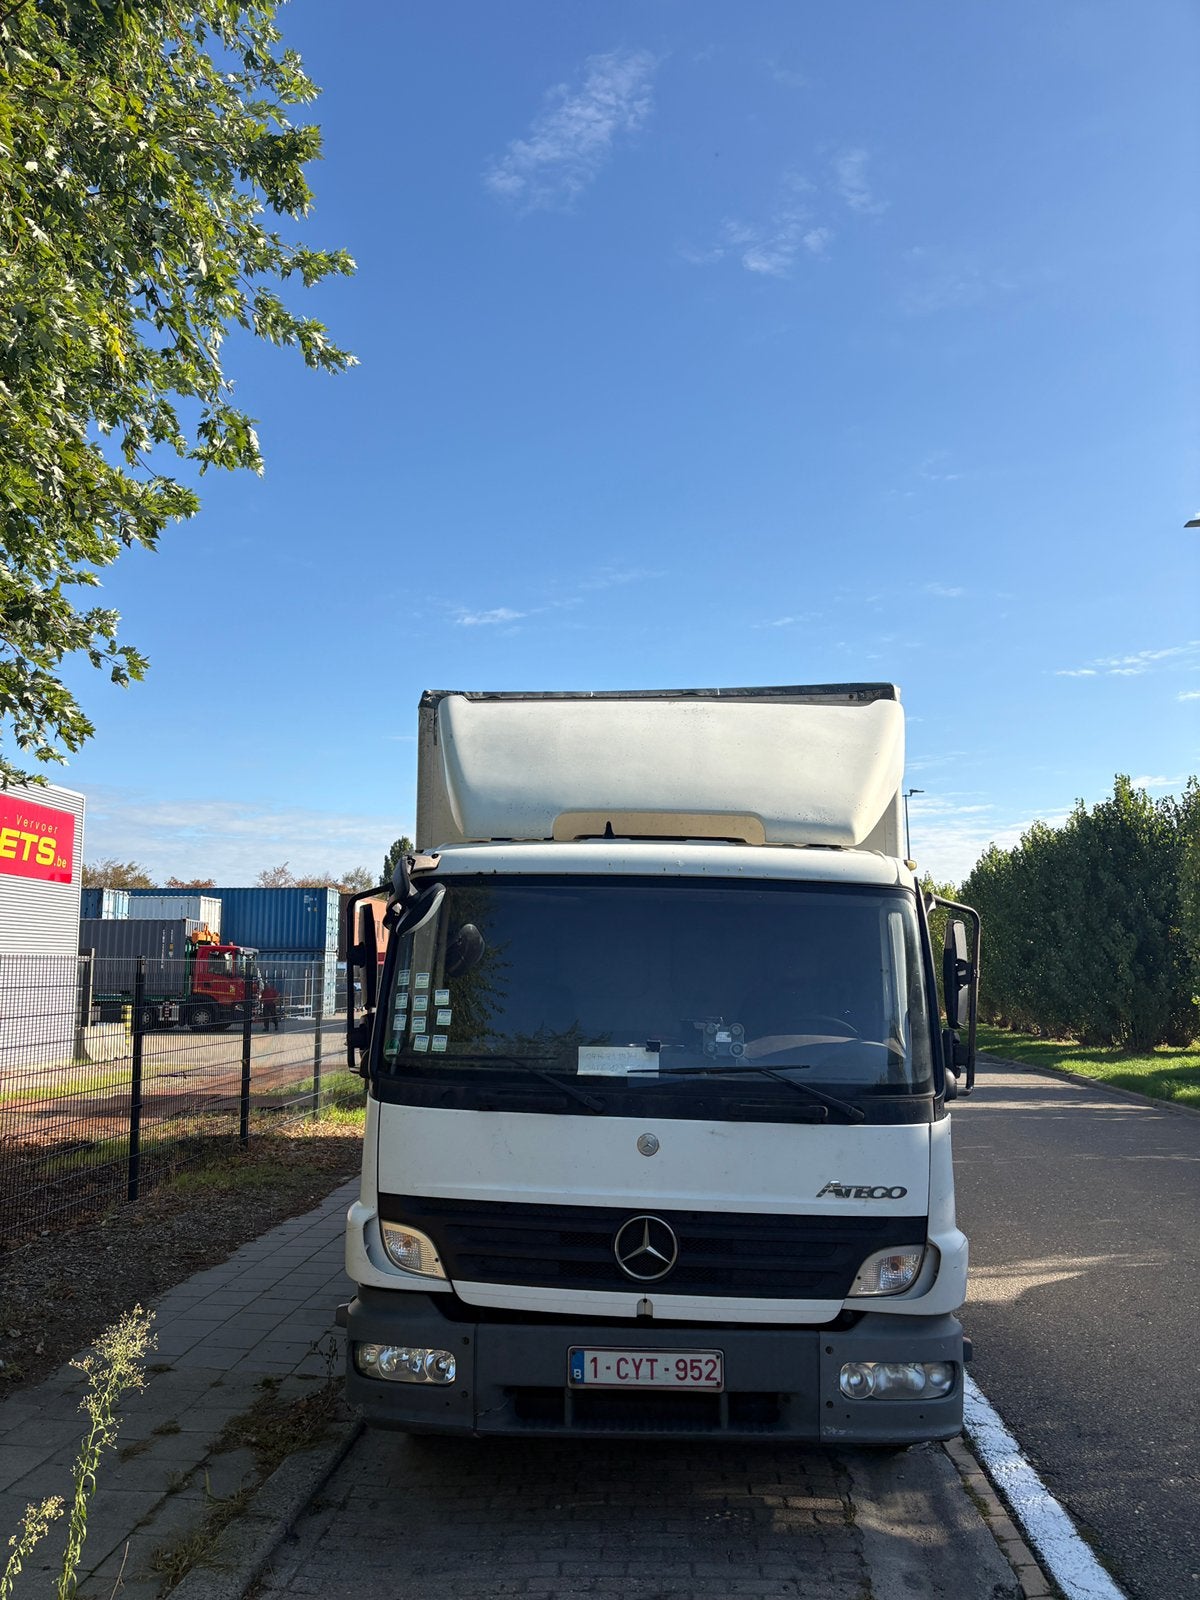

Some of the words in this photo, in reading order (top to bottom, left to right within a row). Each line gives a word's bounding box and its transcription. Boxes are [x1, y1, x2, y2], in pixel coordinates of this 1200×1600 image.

[16, 814, 58, 834] Vervoer
[815, 1179, 908, 1199] ATEGO
[573, 1369, 582, 1379] B
